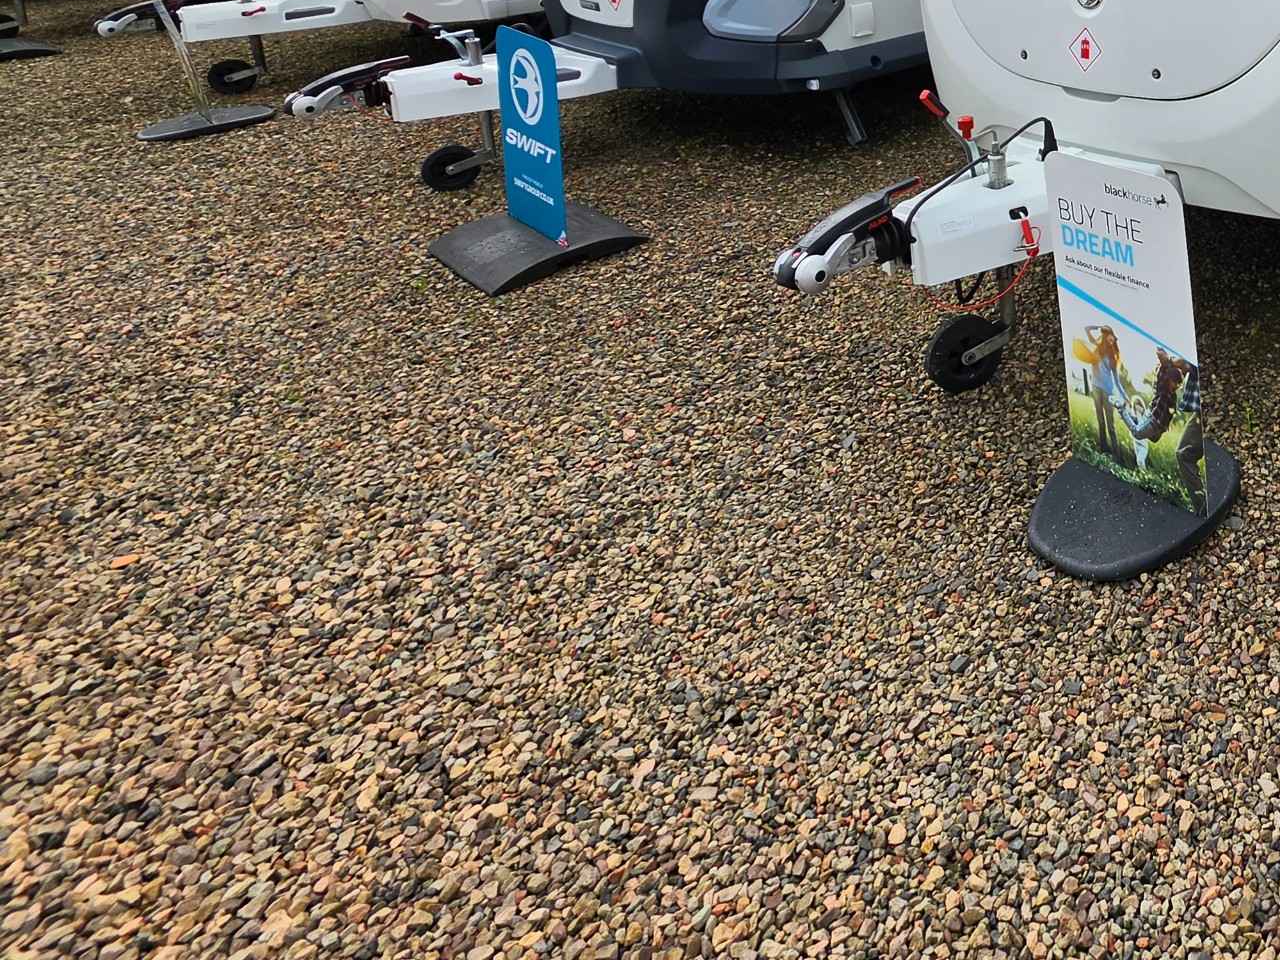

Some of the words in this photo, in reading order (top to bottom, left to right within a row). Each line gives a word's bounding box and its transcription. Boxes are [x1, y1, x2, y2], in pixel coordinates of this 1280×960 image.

[505, 127, 557, 164] SWIFT
[1058, 197, 1096, 229] BUY
[1100, 210, 1144, 244] THE
[1061, 223, 1135, 268] DREAM
[1065, 255, 1076, 265] Ask
[1076, 259, 1093, 271] about
[1093, 265, 1104, 273] our
[1104, 267, 1127, 282] flexible
[1127, 274, 1150, 290] finance
